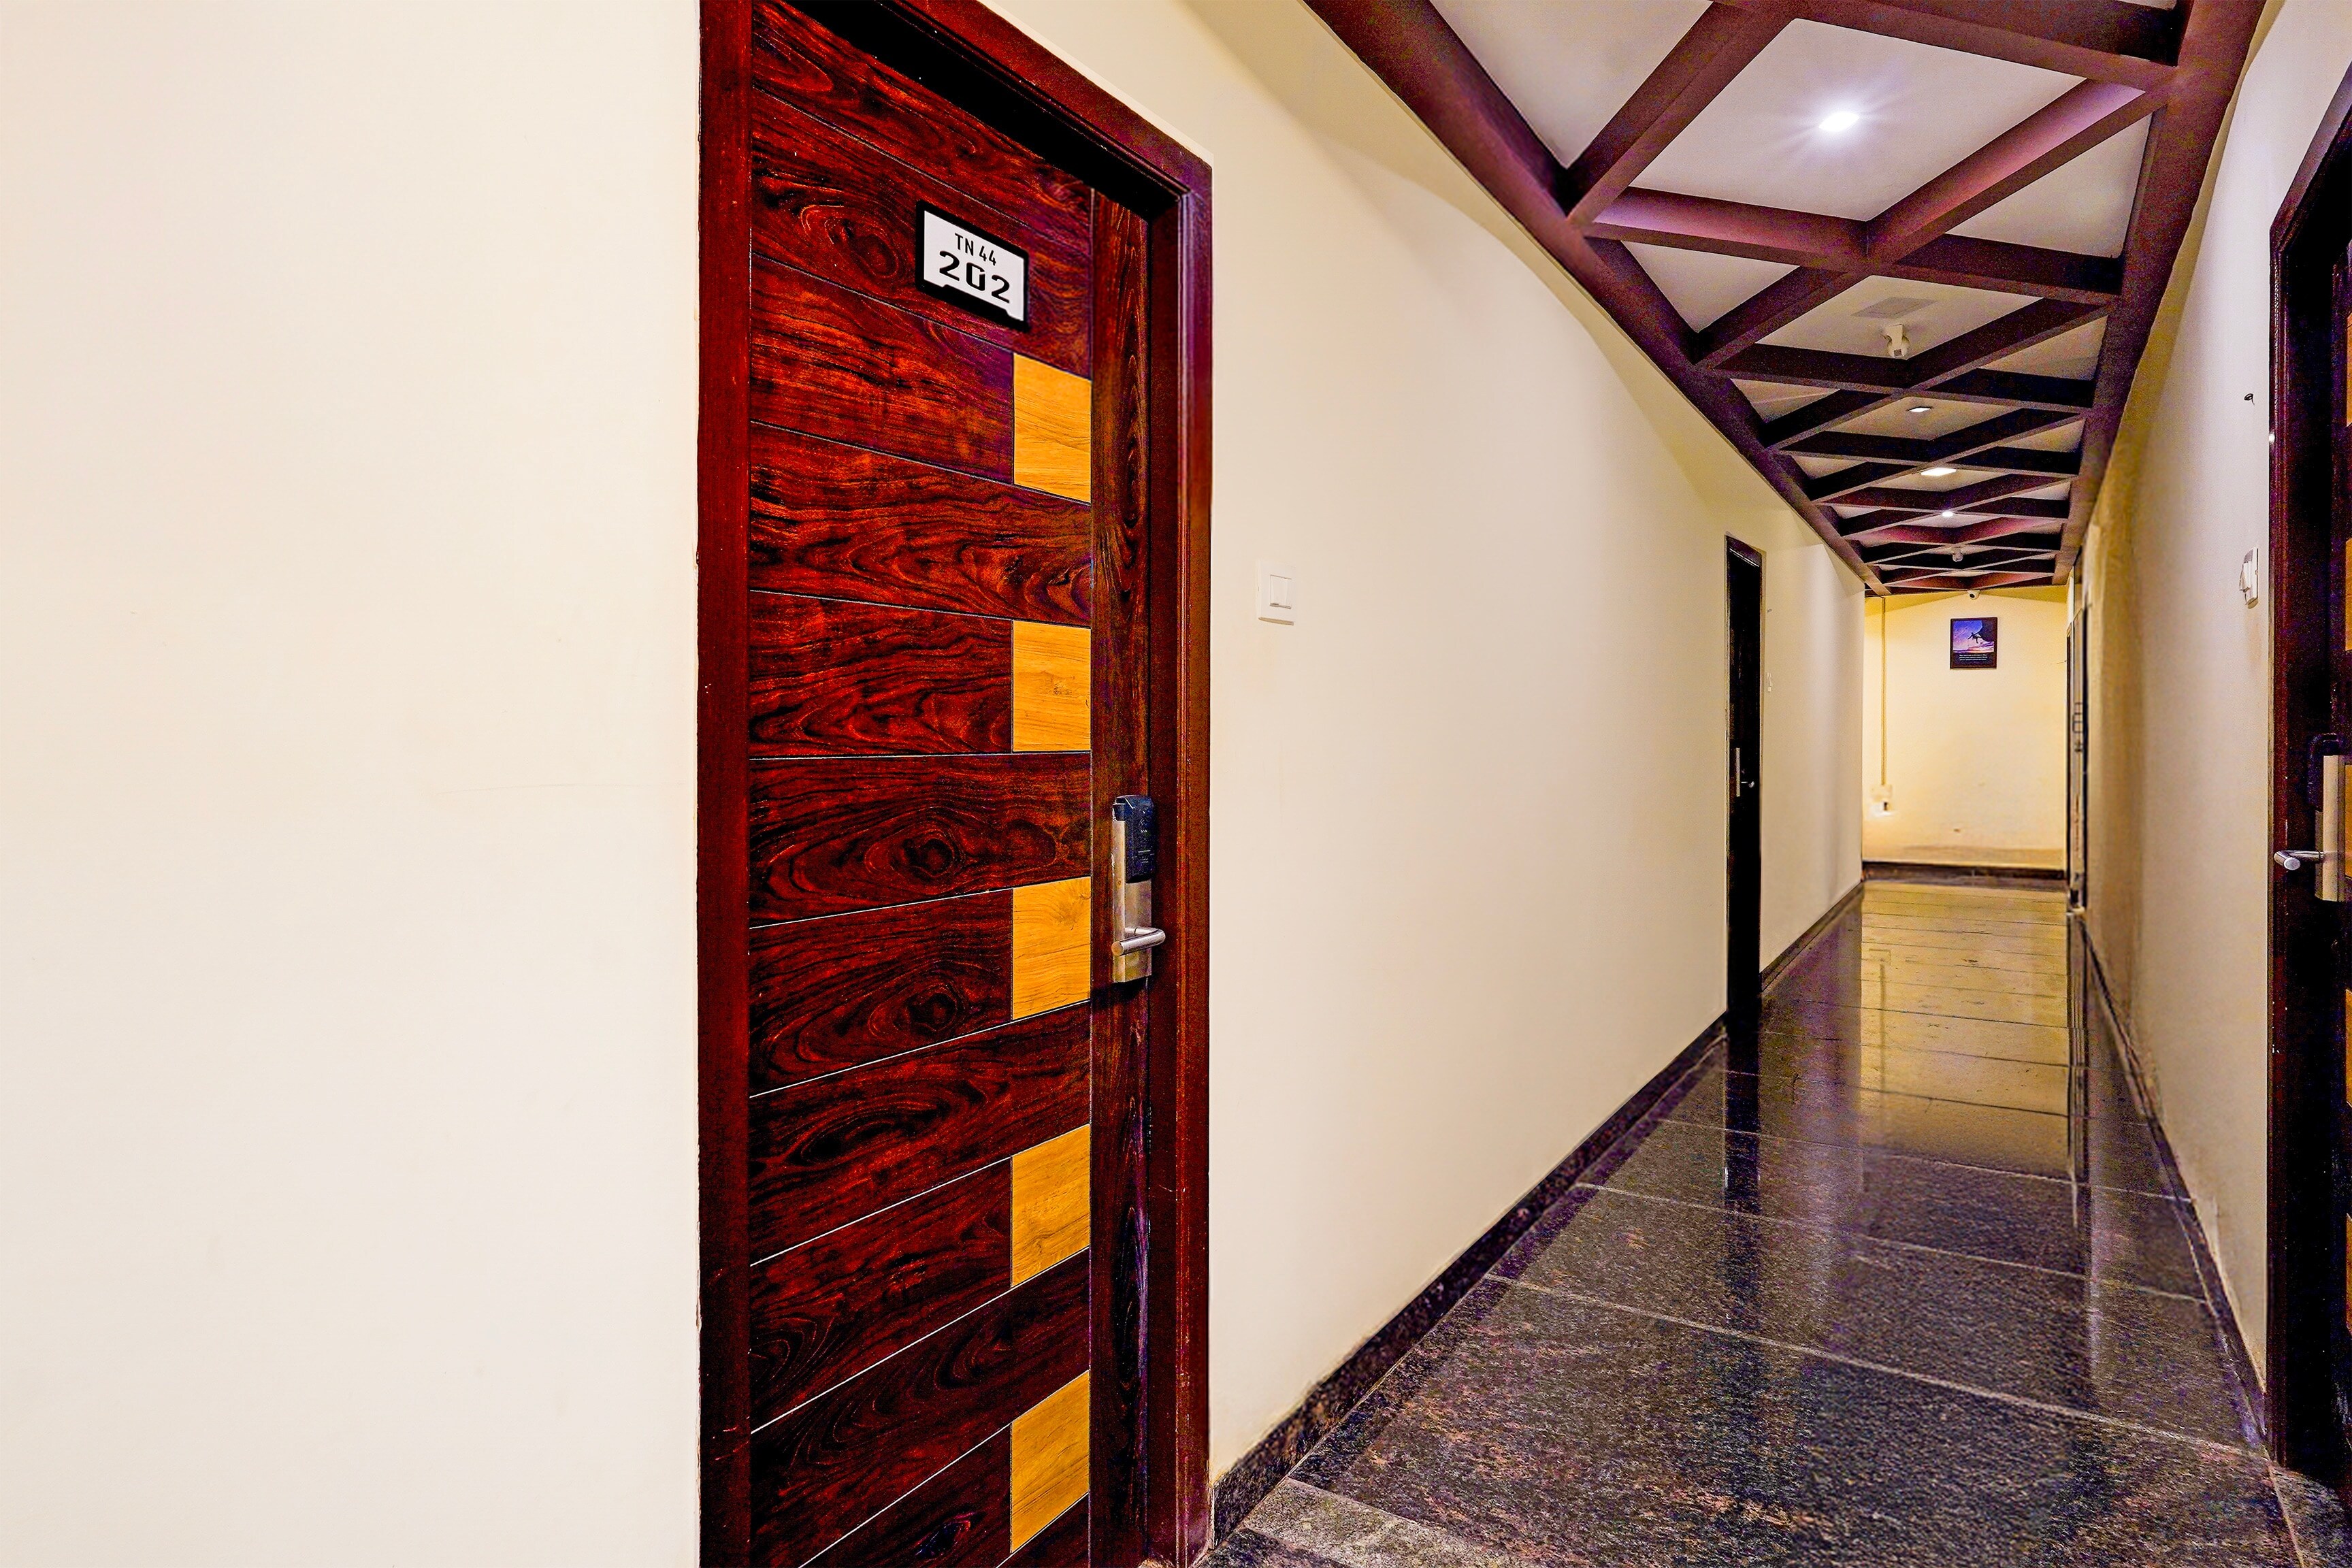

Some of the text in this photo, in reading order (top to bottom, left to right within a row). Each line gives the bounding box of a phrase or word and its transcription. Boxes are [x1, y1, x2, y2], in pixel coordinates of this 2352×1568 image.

[954, 233, 996, 265] TN 44
[939, 250, 1009, 304] 202
